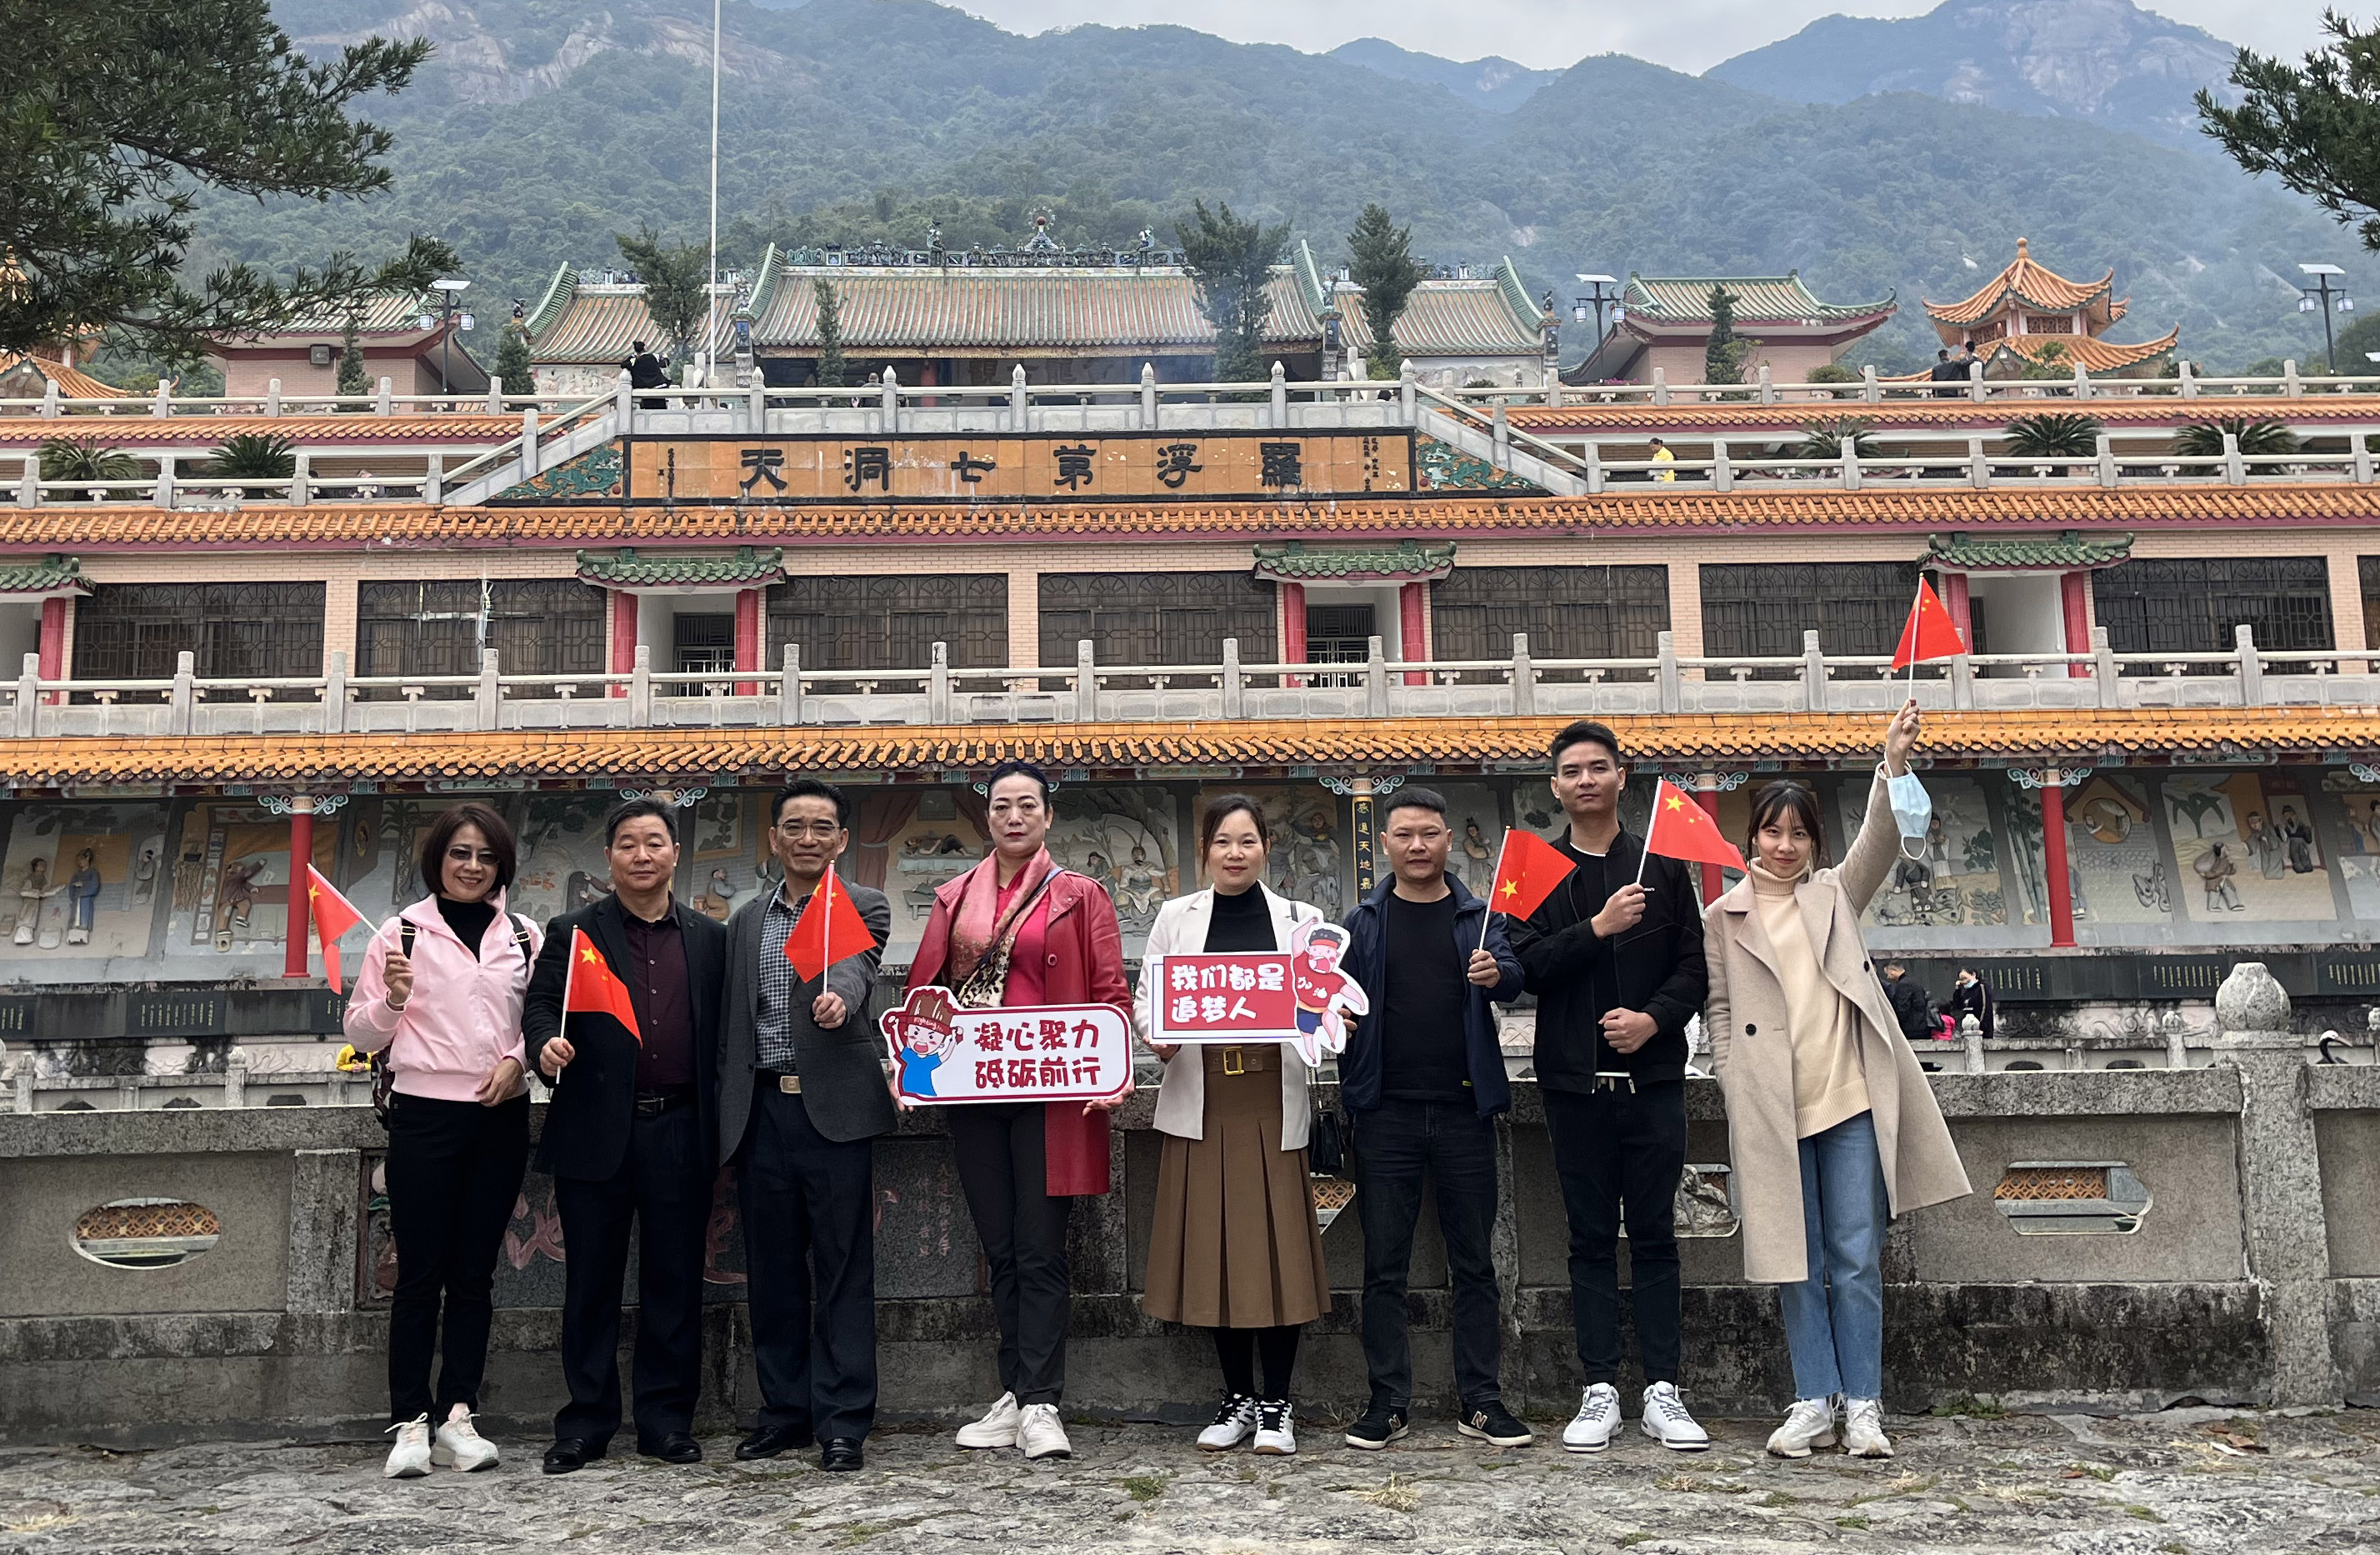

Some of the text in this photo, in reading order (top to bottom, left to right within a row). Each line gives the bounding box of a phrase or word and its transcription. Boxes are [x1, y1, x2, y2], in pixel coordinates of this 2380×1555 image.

[738, 442, 1302, 492] 羅浮第七洞天
[1171, 962, 1285, 992] 我们都是
[1171, 995, 1257, 1023] 追梦人
[974, 1019, 1099, 1051] 凝心聚力
[974, 1056, 1101, 1089] 砥砺前行
[1388, 1413, 1402, 1432] N
[1470, 1411, 1487, 1429] N
